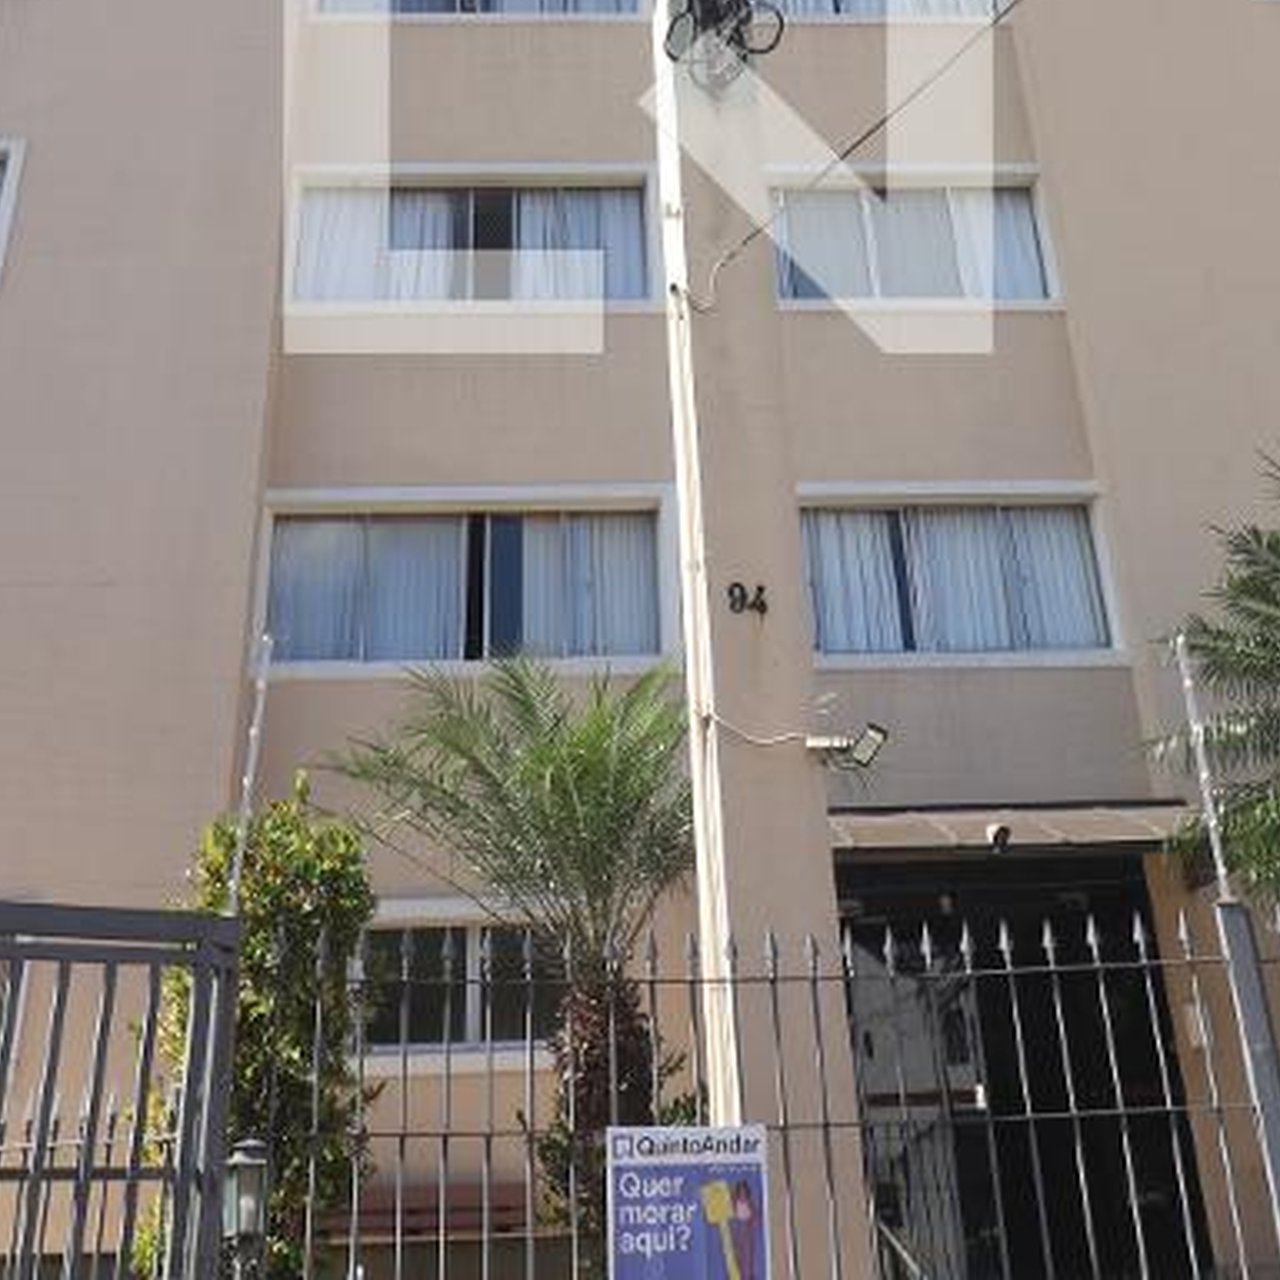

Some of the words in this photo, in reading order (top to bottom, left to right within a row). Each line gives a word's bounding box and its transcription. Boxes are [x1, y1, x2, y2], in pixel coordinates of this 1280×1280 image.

[728, 582, 768, 616] 94
[637, 1134, 760, 1156] QuintoAndar
[619, 1173, 684, 1198] Quer
[620, 1202, 698, 1224] morar
[620, 1225, 692, 1259] aqui?
